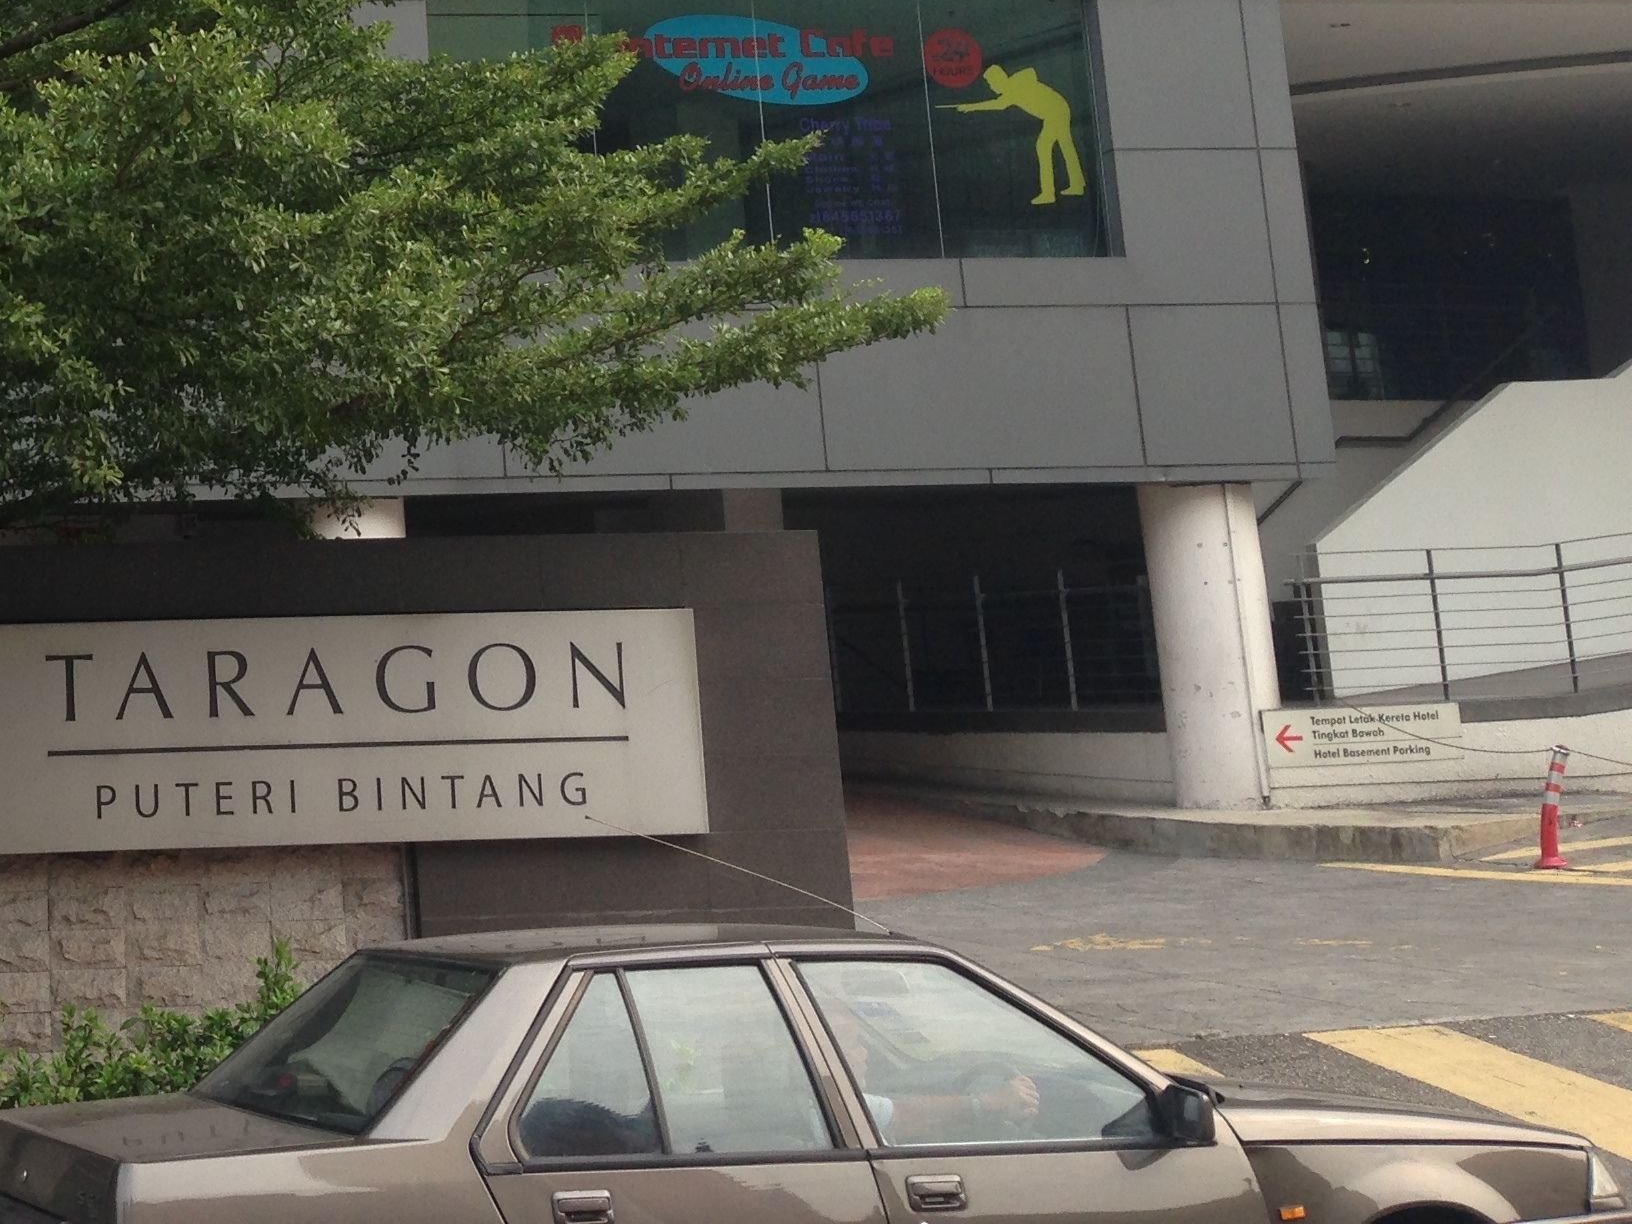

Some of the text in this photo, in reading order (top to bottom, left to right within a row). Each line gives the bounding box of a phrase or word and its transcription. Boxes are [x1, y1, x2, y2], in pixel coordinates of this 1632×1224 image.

[800, 28, 894, 58] Cafe
[678, 61, 859, 101] Online Game
[45, 641, 626, 722] TARAGON
[1310, 710, 1439, 727] Tempat Letak Kereta Hotel
[1312, 727, 1384, 741] Tingkat Bawah
[1314, 745, 1431, 759] Hotel Basement Parking
[95, 771, 587, 821] PUTERI BINTANG
